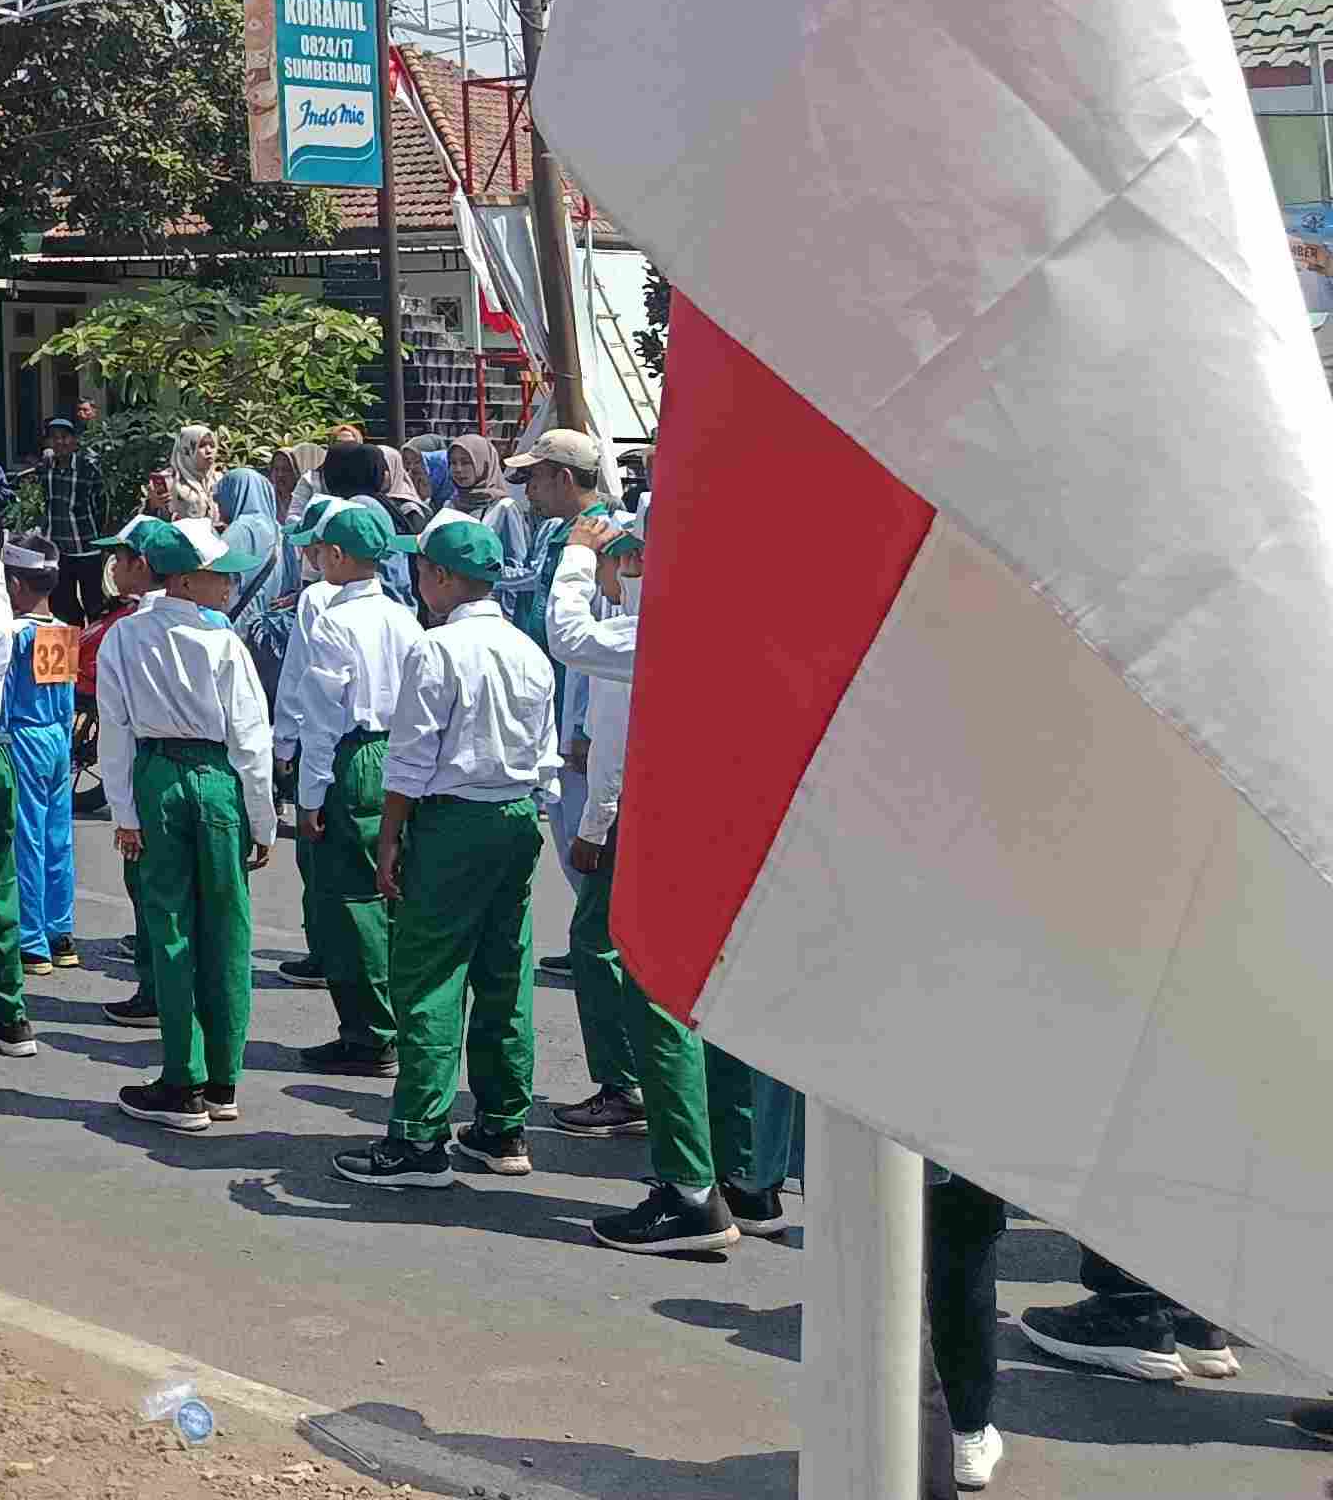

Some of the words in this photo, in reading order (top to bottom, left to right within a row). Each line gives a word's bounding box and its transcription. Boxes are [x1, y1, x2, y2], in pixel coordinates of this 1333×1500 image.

[299, 33, 354, 58] 0824/17
[283, 55, 373, 86] SUMBERBARU
[36, 643, 65, 676] 32
